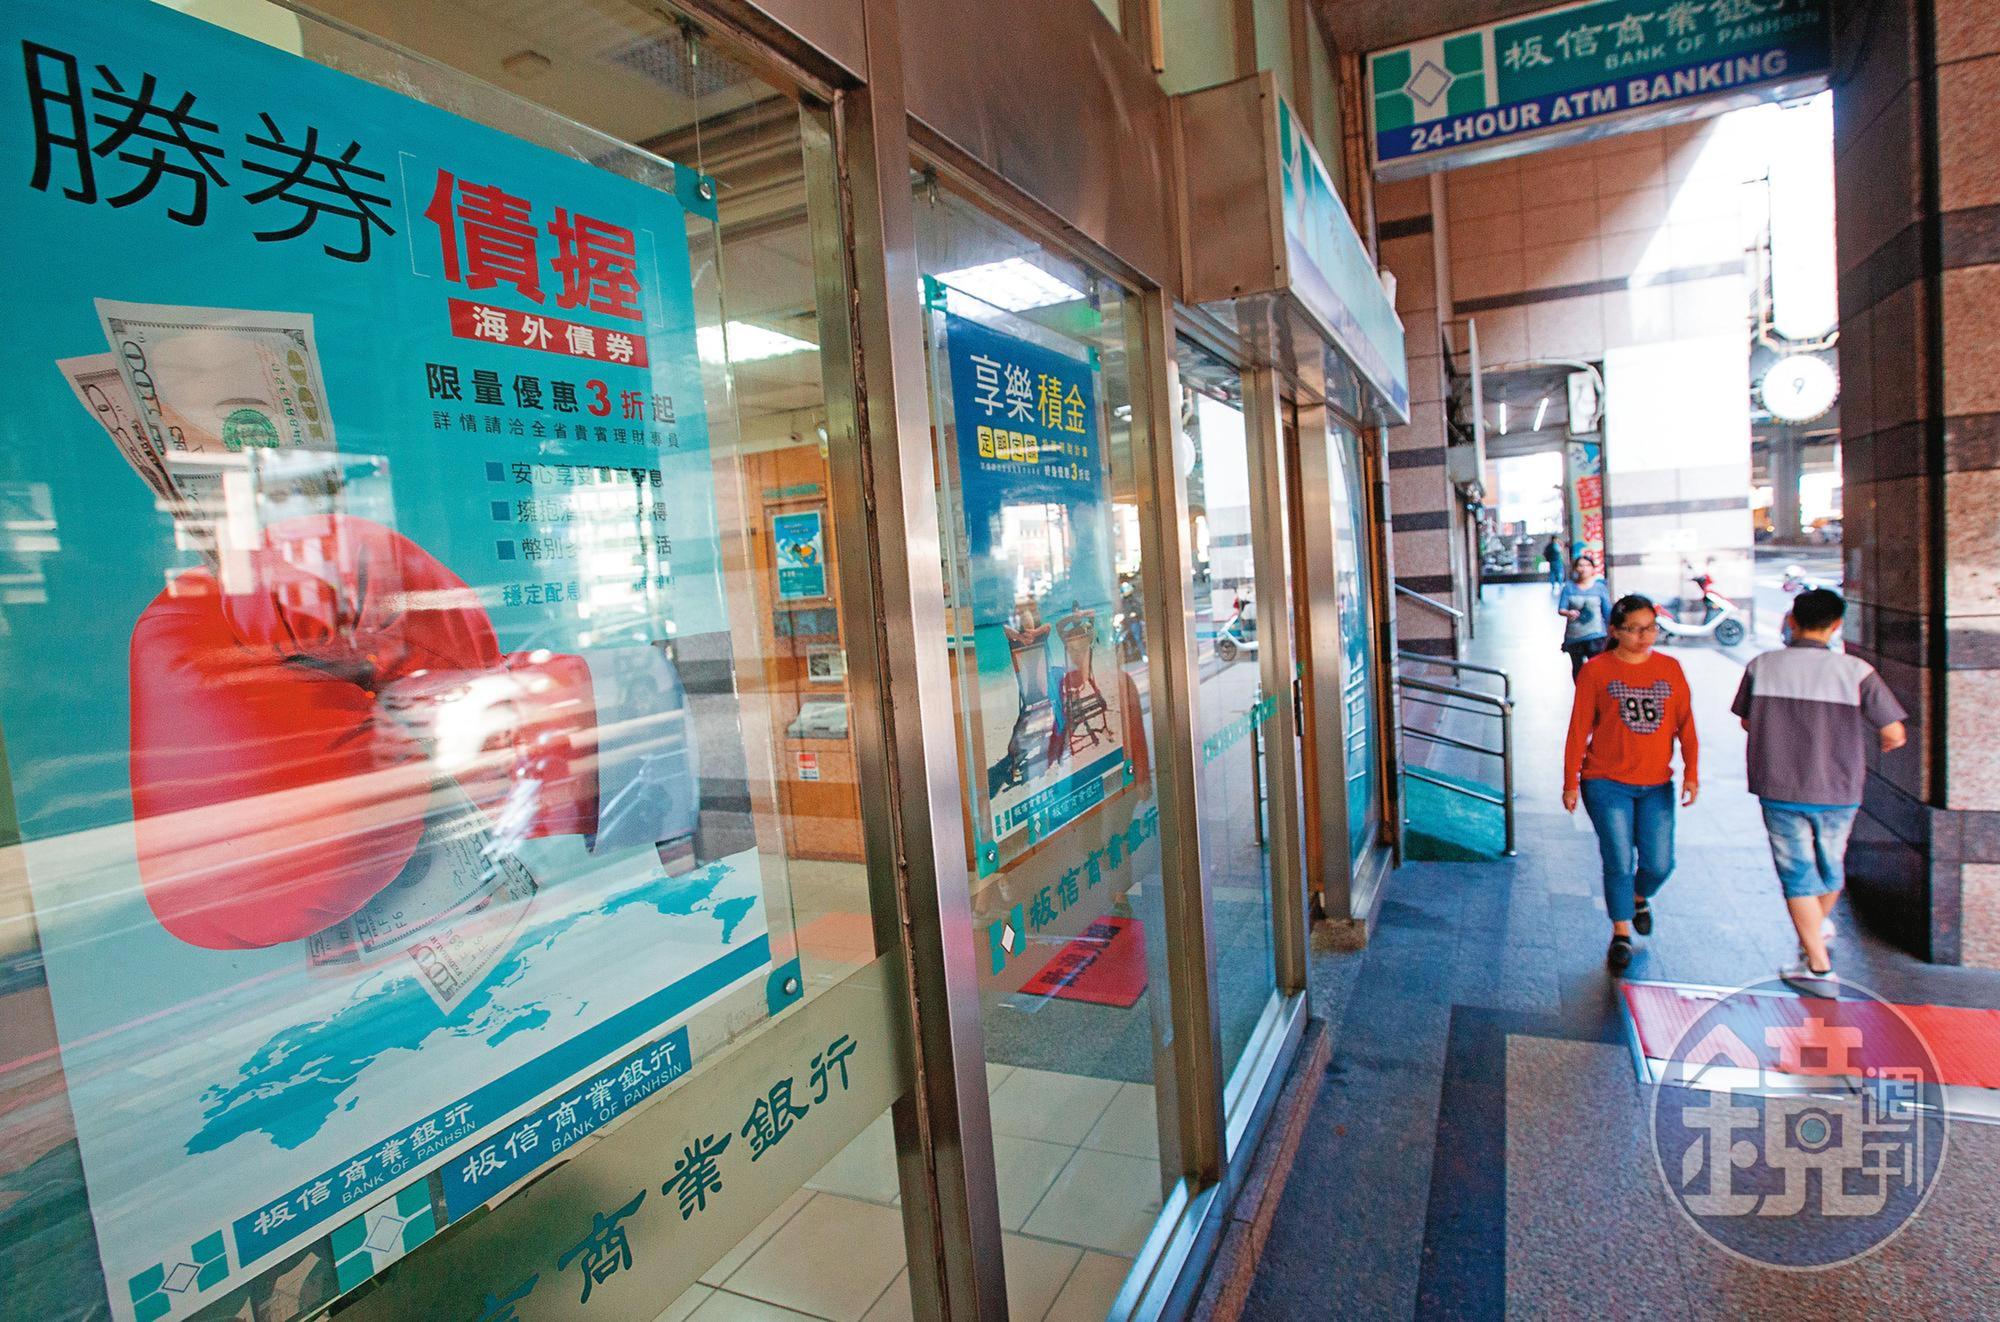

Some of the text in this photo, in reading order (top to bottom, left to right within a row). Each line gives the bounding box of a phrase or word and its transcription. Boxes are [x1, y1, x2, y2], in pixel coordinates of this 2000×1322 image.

[1605, 43, 1665, 70] BANK
[1676, 37, 1704, 54] OF
[1410, 49, 1789, 153] 24-HOUR ATM BANKING
[22, 39, 396, 264] 勝券
[423, 167, 643, 322] 債握
[472, 305, 634, 364] 海外債券
[424, 361, 676, 424] 限量優惠3折起
[432, 411, 680, 449] 詳情請洽全省貴賓理財專員
[970, 354, 1087, 434] 享樂積金
[1626, 698, 1656, 721] 96
[462, 1041, 677, 1184] 板信商業銀行
[551, 1061, 683, 1153] BANK OF PANHSIN
[253, 1102, 474, 1236] 板信商業銀行
[342, 1120, 476, 1204] BANK OF PANHSIN
